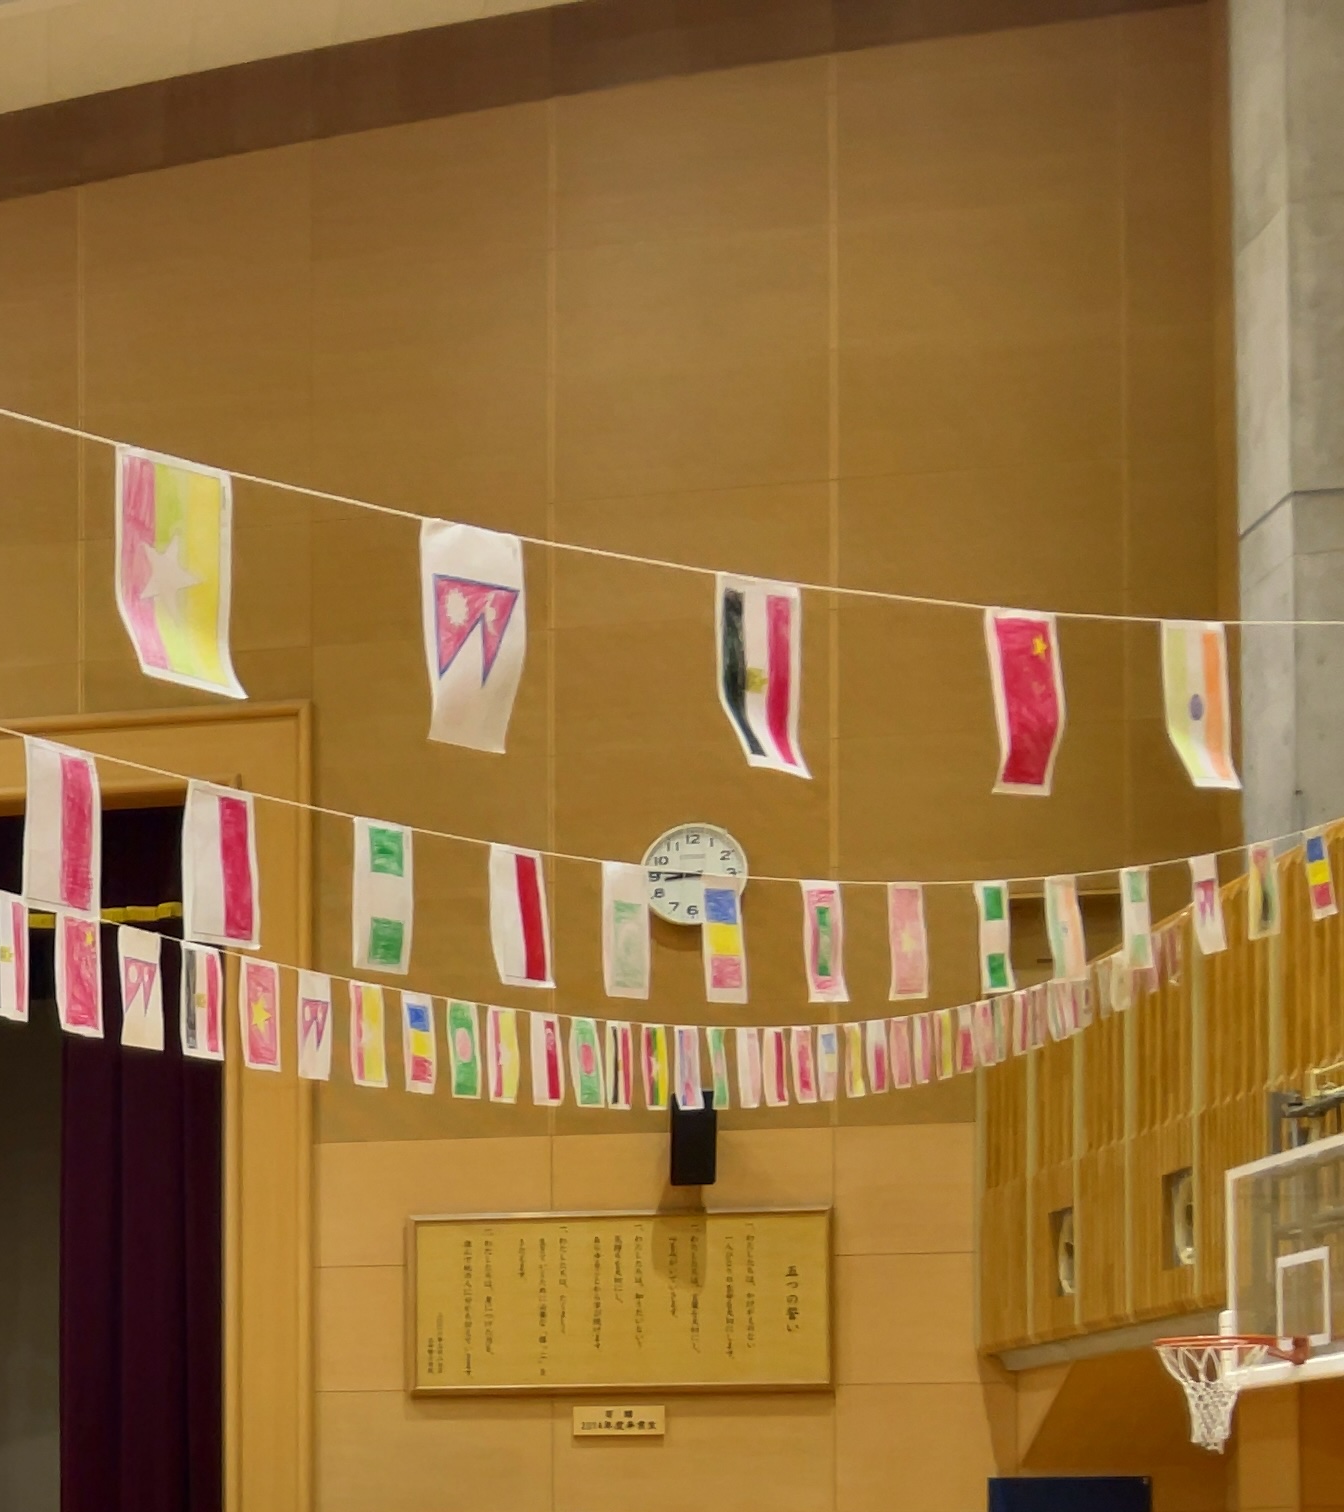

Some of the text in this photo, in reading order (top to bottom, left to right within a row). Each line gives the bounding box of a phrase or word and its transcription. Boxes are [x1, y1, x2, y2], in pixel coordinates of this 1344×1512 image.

[685, 834, 701, 845] 12
[666, 841, 680, 851] 11
[720, 850, 732, 861] 2
[654, 856, 669, 866] 10
[654, 888, 665, 898] 8
[668, 902, 680, 912] 7
[687, 905, 699, 916] 6
[785, 1265, 800, 1332] 五つの誓い
